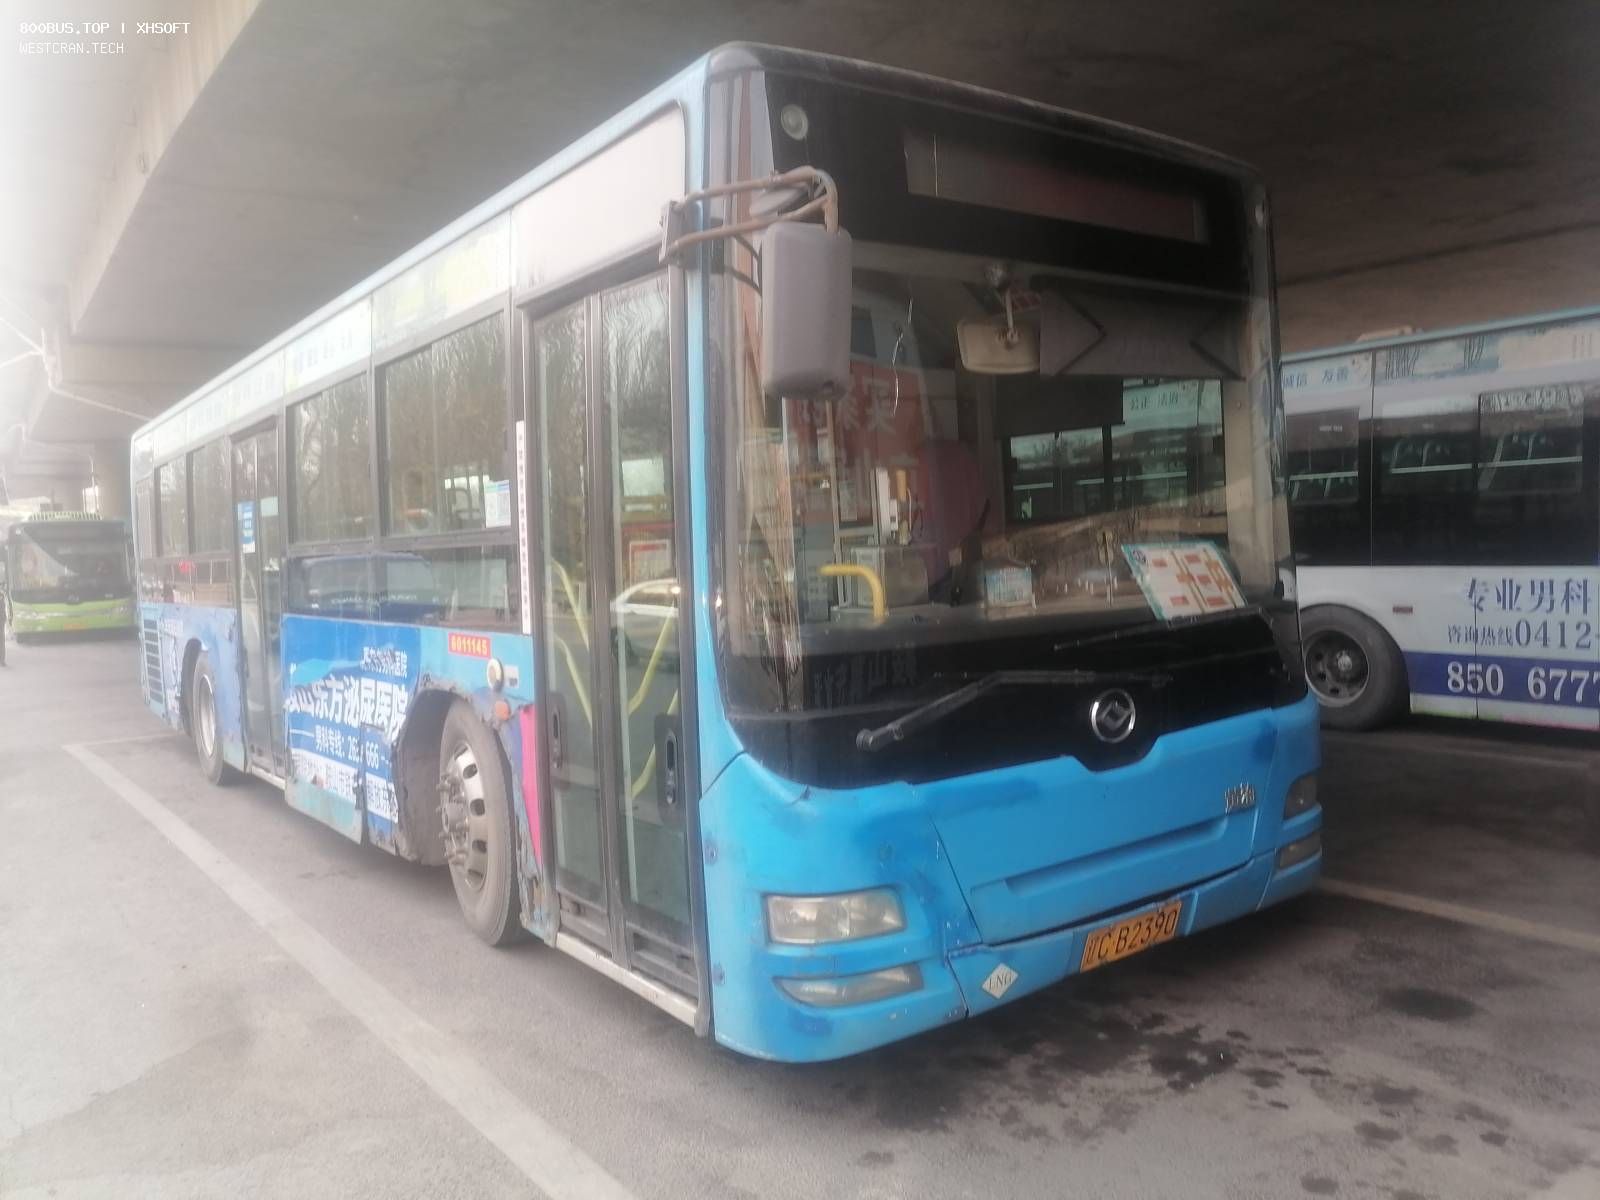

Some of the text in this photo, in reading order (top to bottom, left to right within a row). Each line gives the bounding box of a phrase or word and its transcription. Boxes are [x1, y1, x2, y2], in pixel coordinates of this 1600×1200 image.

[1465, 577, 1591, 616] 专业男科
[1446, 660, 1504, 696] 850
